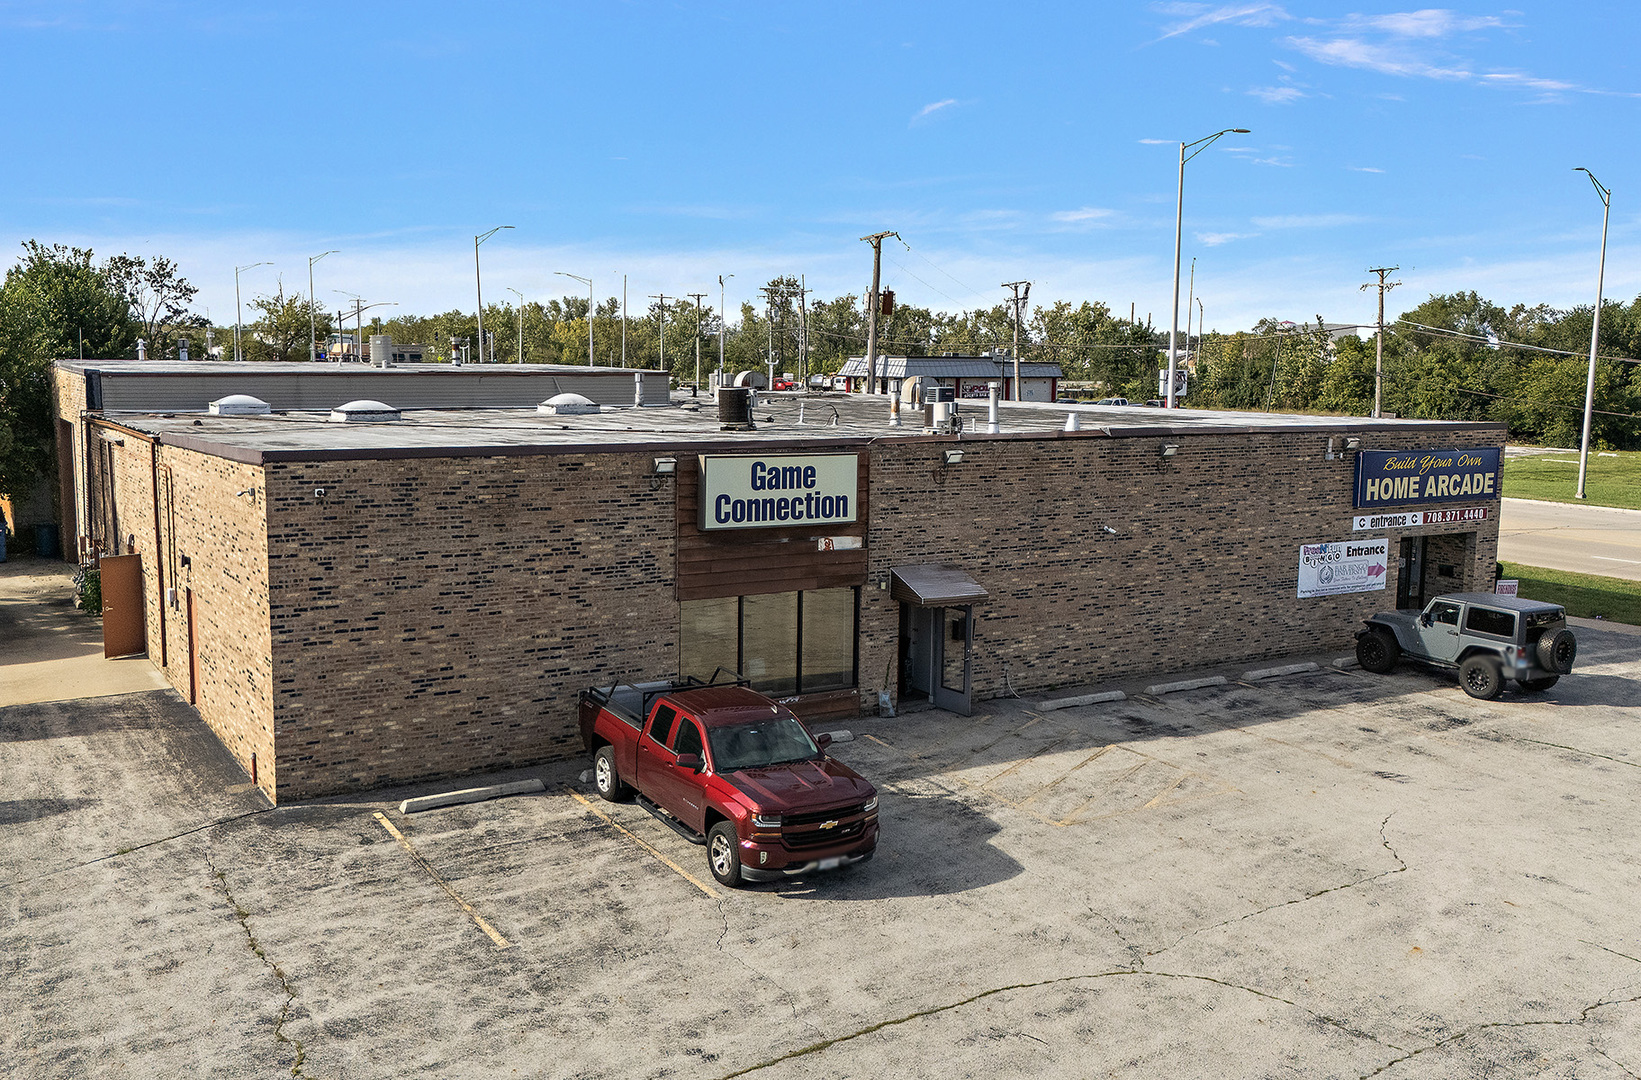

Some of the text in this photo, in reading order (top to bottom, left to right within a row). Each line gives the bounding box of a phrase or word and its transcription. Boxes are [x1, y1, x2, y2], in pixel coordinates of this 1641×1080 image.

[751, 461, 816, 491] Game
[1383, 453, 1482, 475] Build Your Own
[1366, 472, 1495, 501] HOME ARCADE
[715, 490, 849, 524] Connection
[1370, 514, 1407, 528] entrance
[1427, 508, 1484, 523] 708.371.4440
[1346, 545, 1385, 557] Entrance
